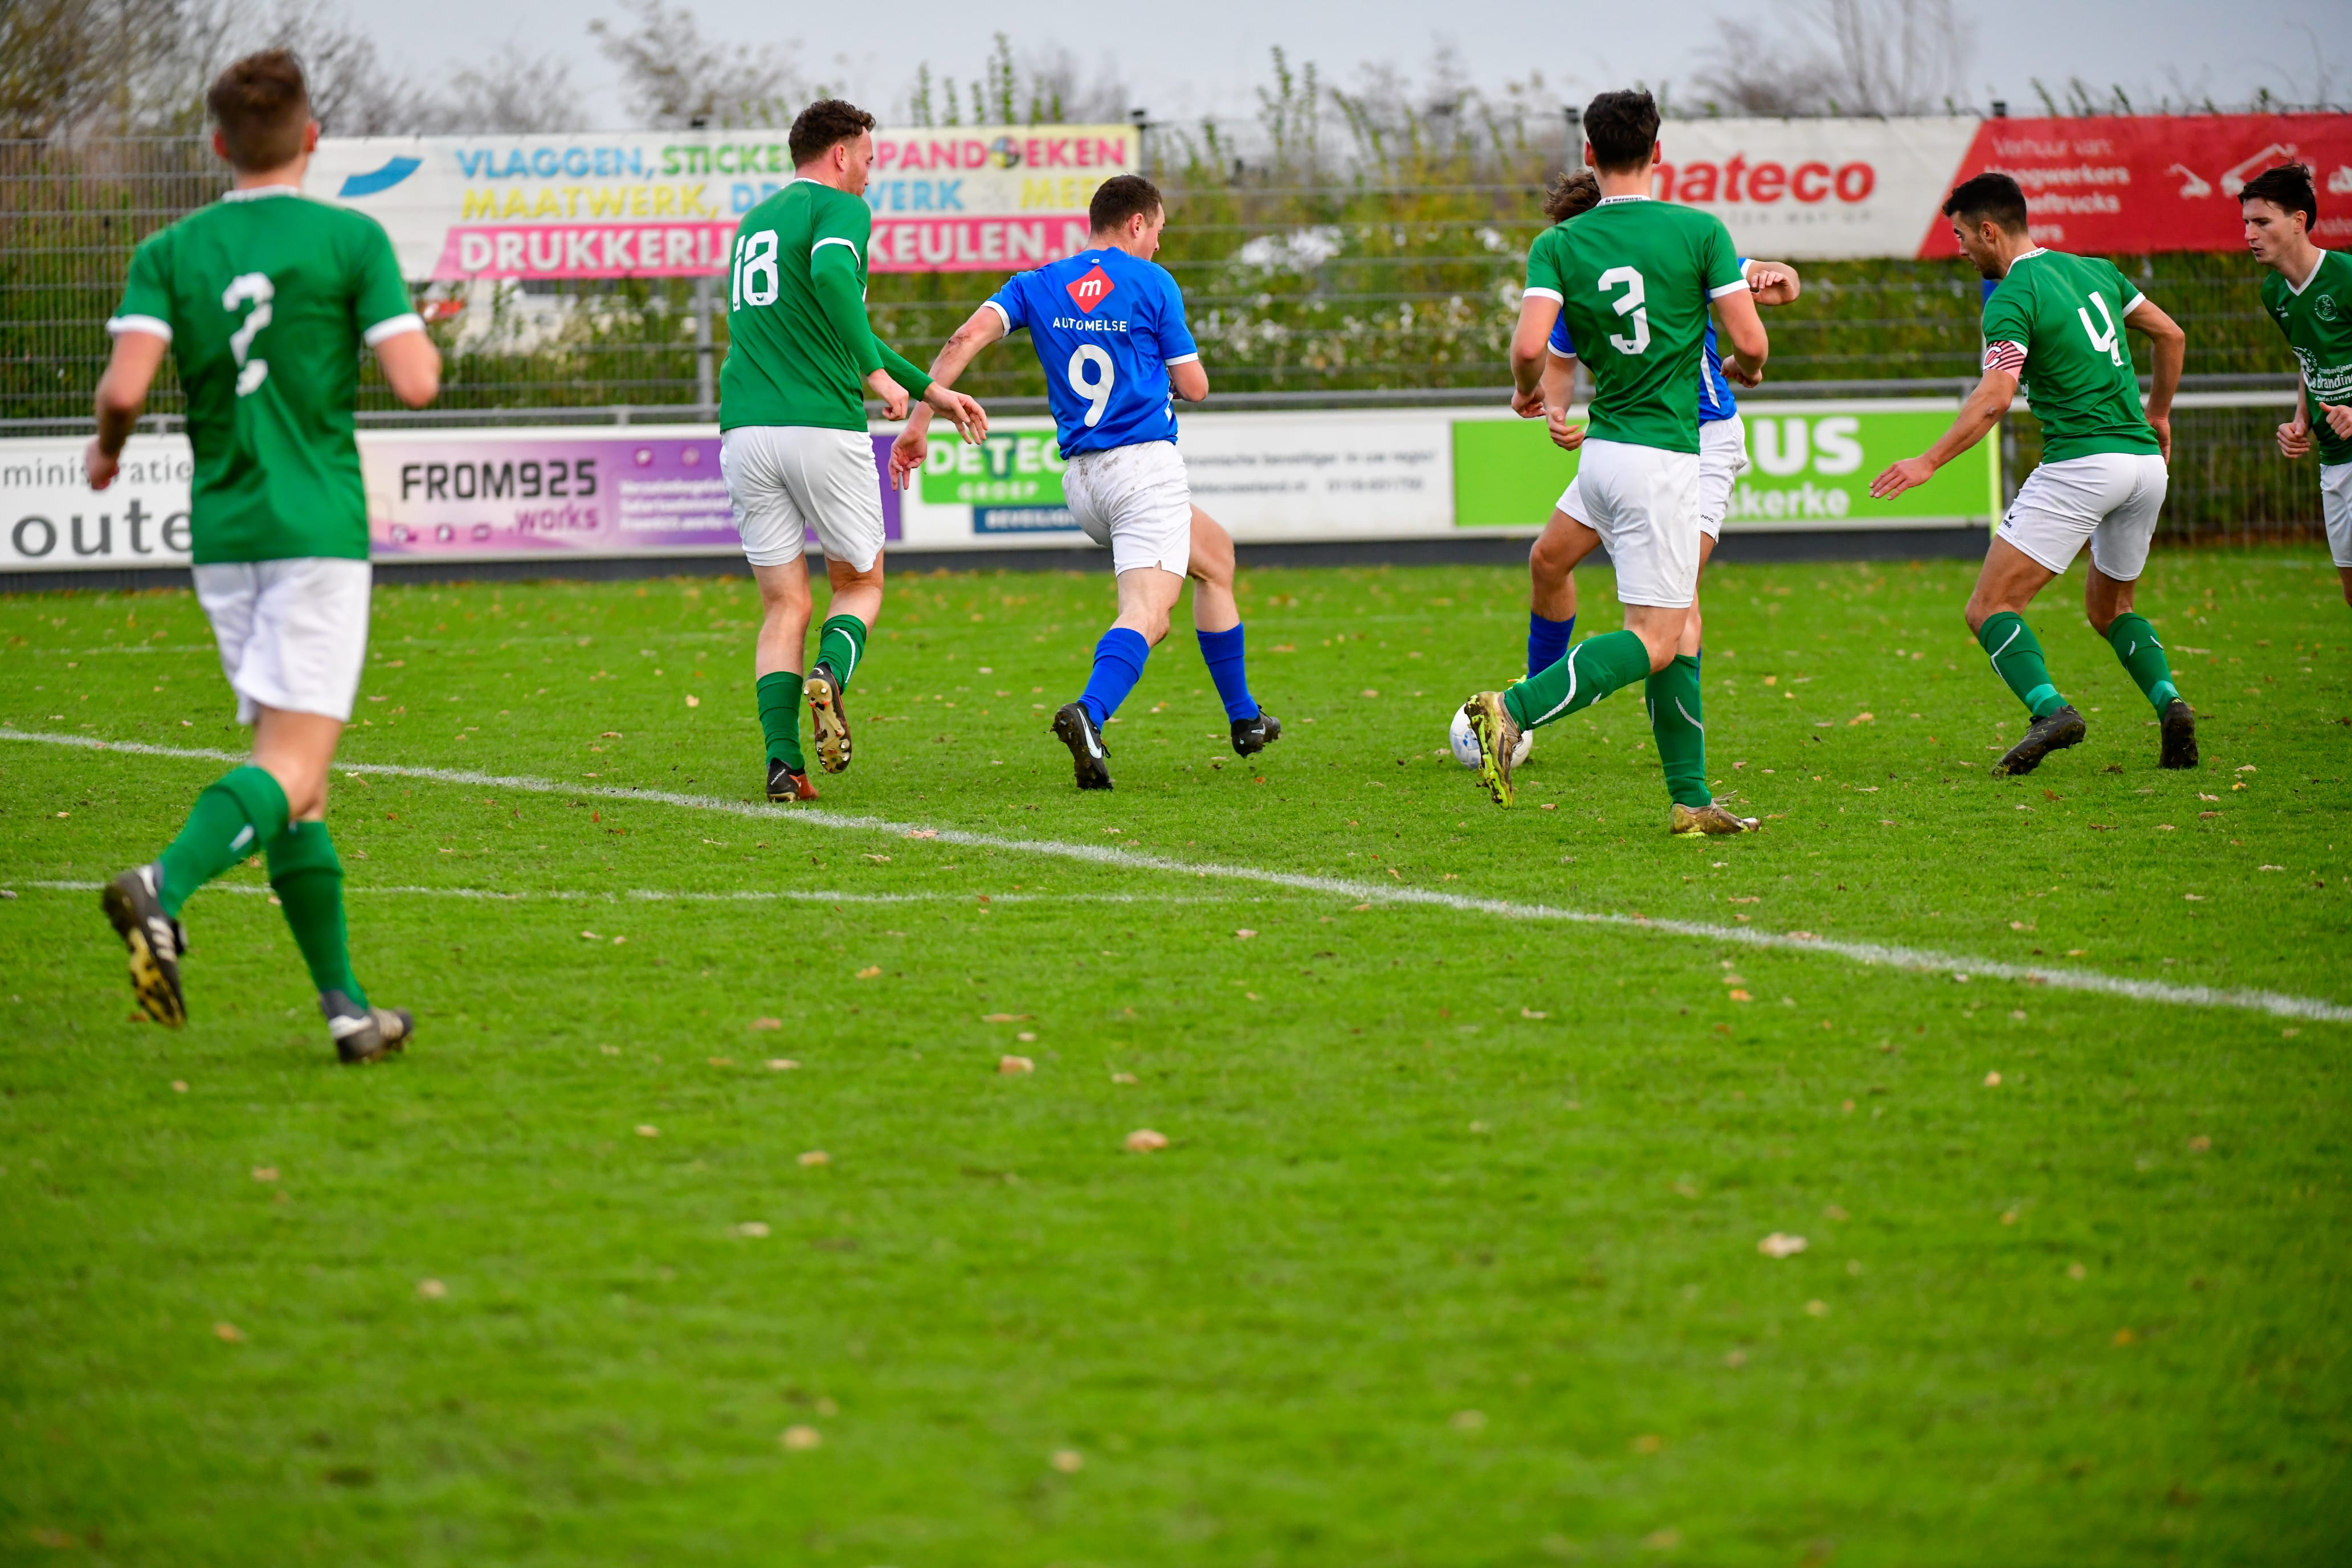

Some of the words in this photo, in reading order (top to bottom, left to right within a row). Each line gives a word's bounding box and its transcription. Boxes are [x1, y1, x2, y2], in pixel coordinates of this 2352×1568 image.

[456, 146, 654, 181] VLAGGEN,
[662, 142, 795, 174] STICKE
[461, 182, 720, 220] MAATWERK,
[1020, 177, 1111, 209] MEE
[732, 229, 779, 312] 18
[222, 271, 275, 398] 2
[1052, 317, 1128, 332] AUTOMELSE
[1598, 266, 1651, 355] 3
[2077, 291, 2124, 367] 4
[1068, 344, 1115, 428] 9
[1738, 416, 1864, 476] US
[402, 460, 598, 501] FROM925
